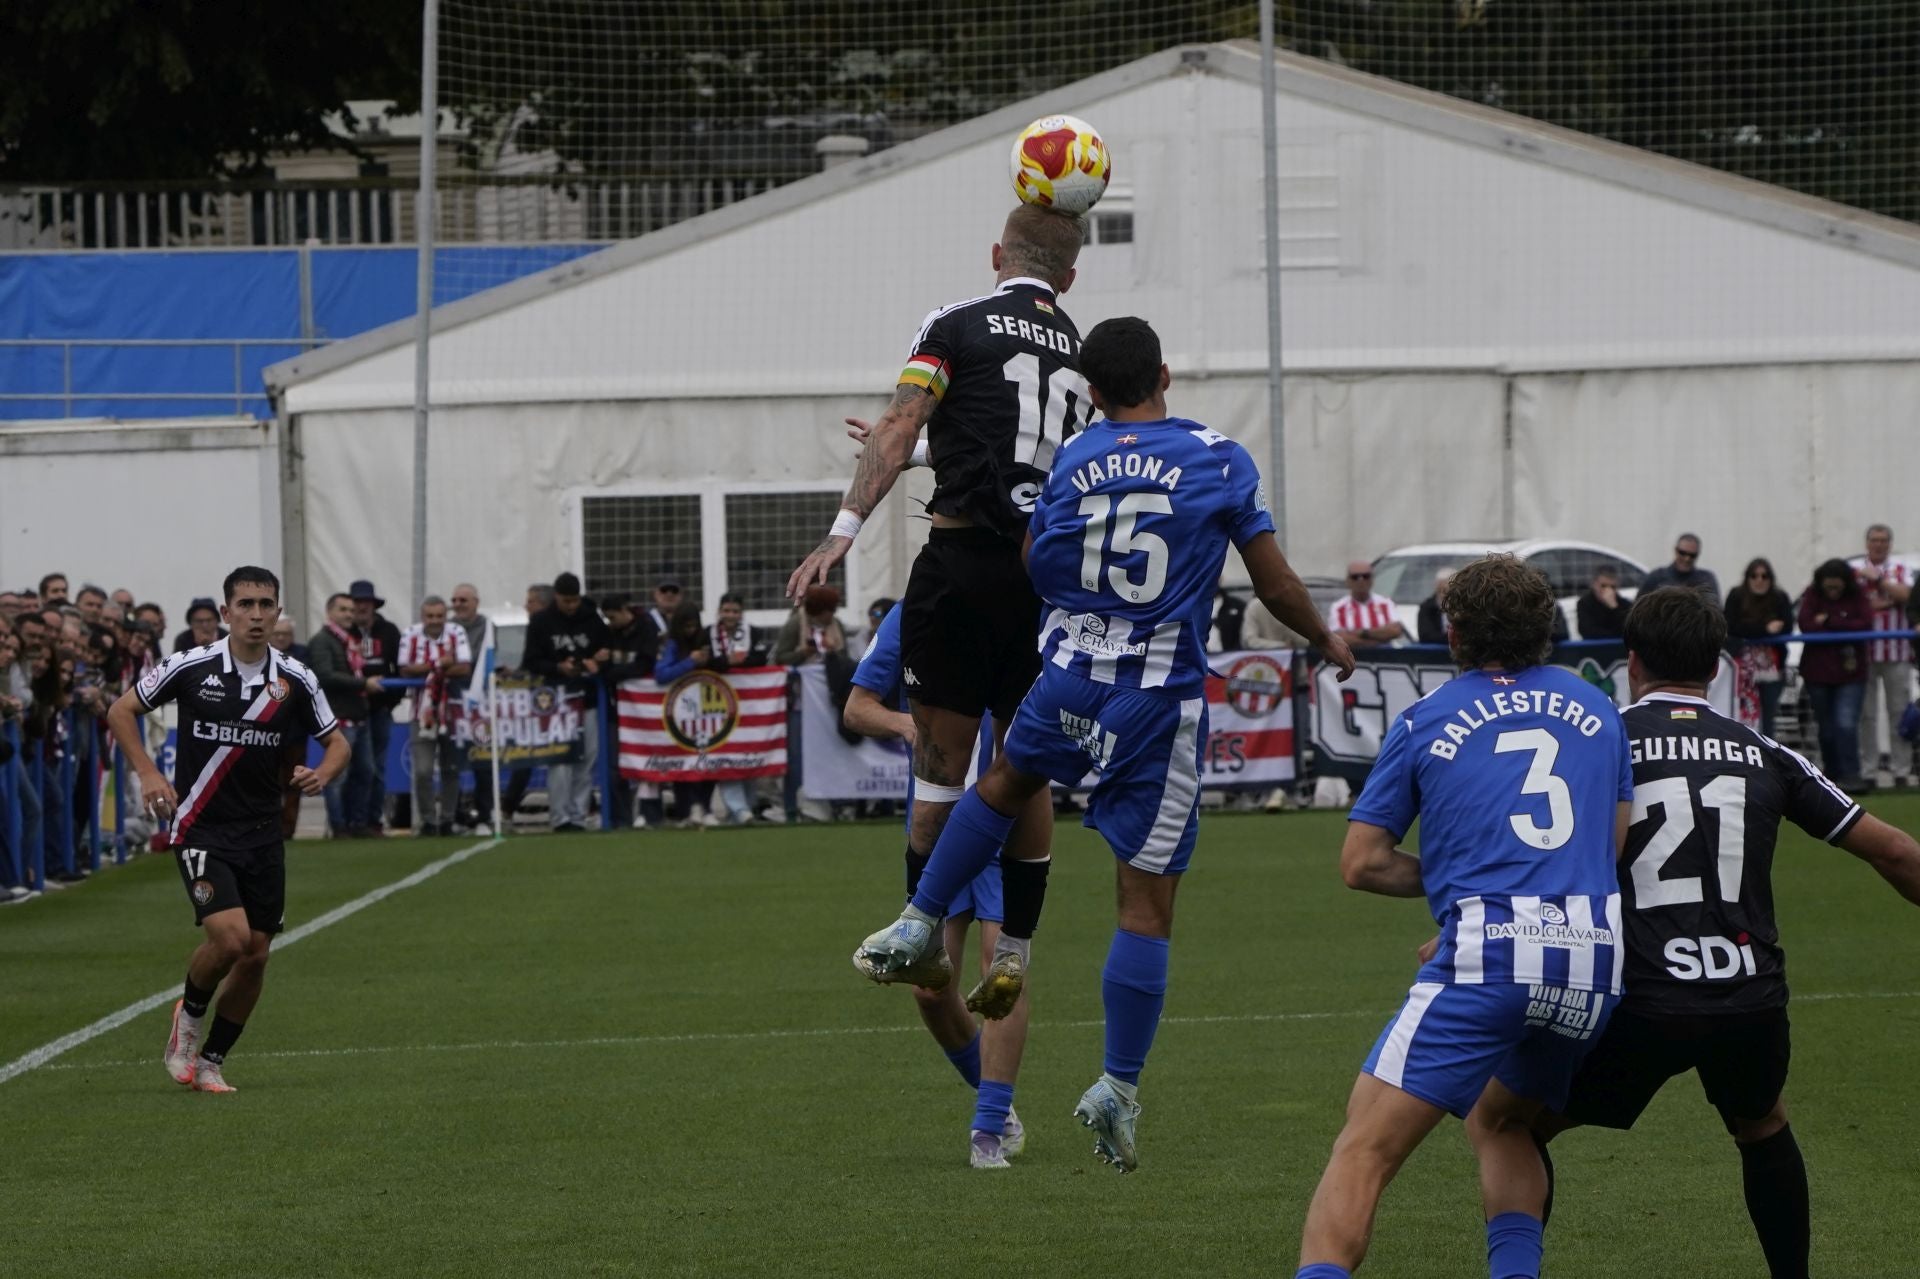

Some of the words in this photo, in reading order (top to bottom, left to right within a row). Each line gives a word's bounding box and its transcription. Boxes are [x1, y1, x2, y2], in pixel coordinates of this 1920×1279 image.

[986, 314, 1071, 355] SERGIO
[1002, 352, 1096, 473] 10
[1071, 453, 1183, 494] VARONA
[1077, 492, 1174, 604] 15
[1429, 690, 1602, 761] BALLESTERO
[1494, 727, 1575, 851] 3
[182, 848, 208, 880] 17
[1629, 774, 1746, 910] 21
[1488, 925, 1540, 937] DAVID
